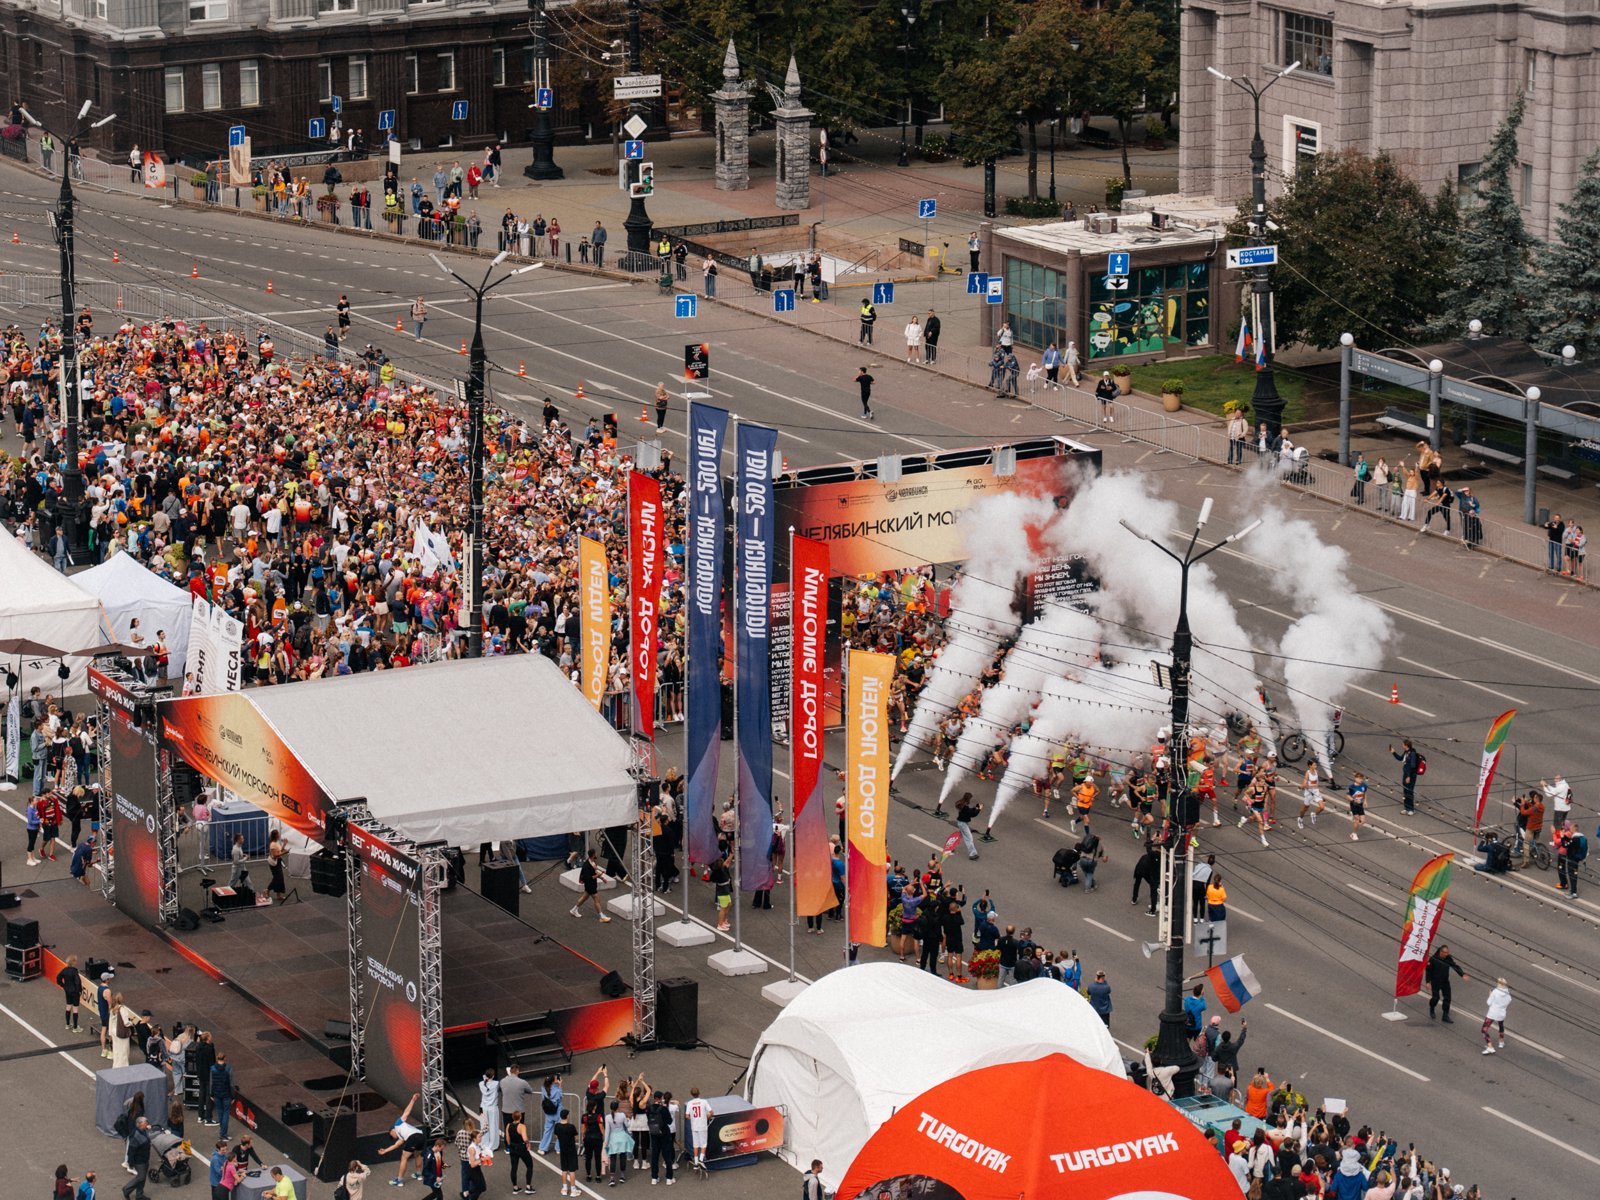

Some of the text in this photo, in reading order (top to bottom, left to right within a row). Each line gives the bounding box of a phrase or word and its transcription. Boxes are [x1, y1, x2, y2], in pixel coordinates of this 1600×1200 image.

[1240, 248, 1274, 257] КОСТАНАЙ
[799, 511, 923, 542] ЧЕЛЯБИНСКИЙ
[1034, 572, 1070, 582] МЫ ЗНАЕМ,
[90, 676, 102, 690] БЕГ
[106, 686, 122, 704] ДРАЙВ
[192, 741, 241, 780] ЧЕЛЯБИНСКИЙ
[241, 771, 280, 804] МАРАФОН
[352, 832, 366, 849] БЕГ
[370, 844, 392, 866] ДРАЙВ
[392, 857, 416, 880] ЖИЗНИ
[692, 1106, 701, 1118] 31
[916, 1112, 1012, 1174] TURGOYAK
[1050, 1132, 1179, 1174] TURGOYAK
